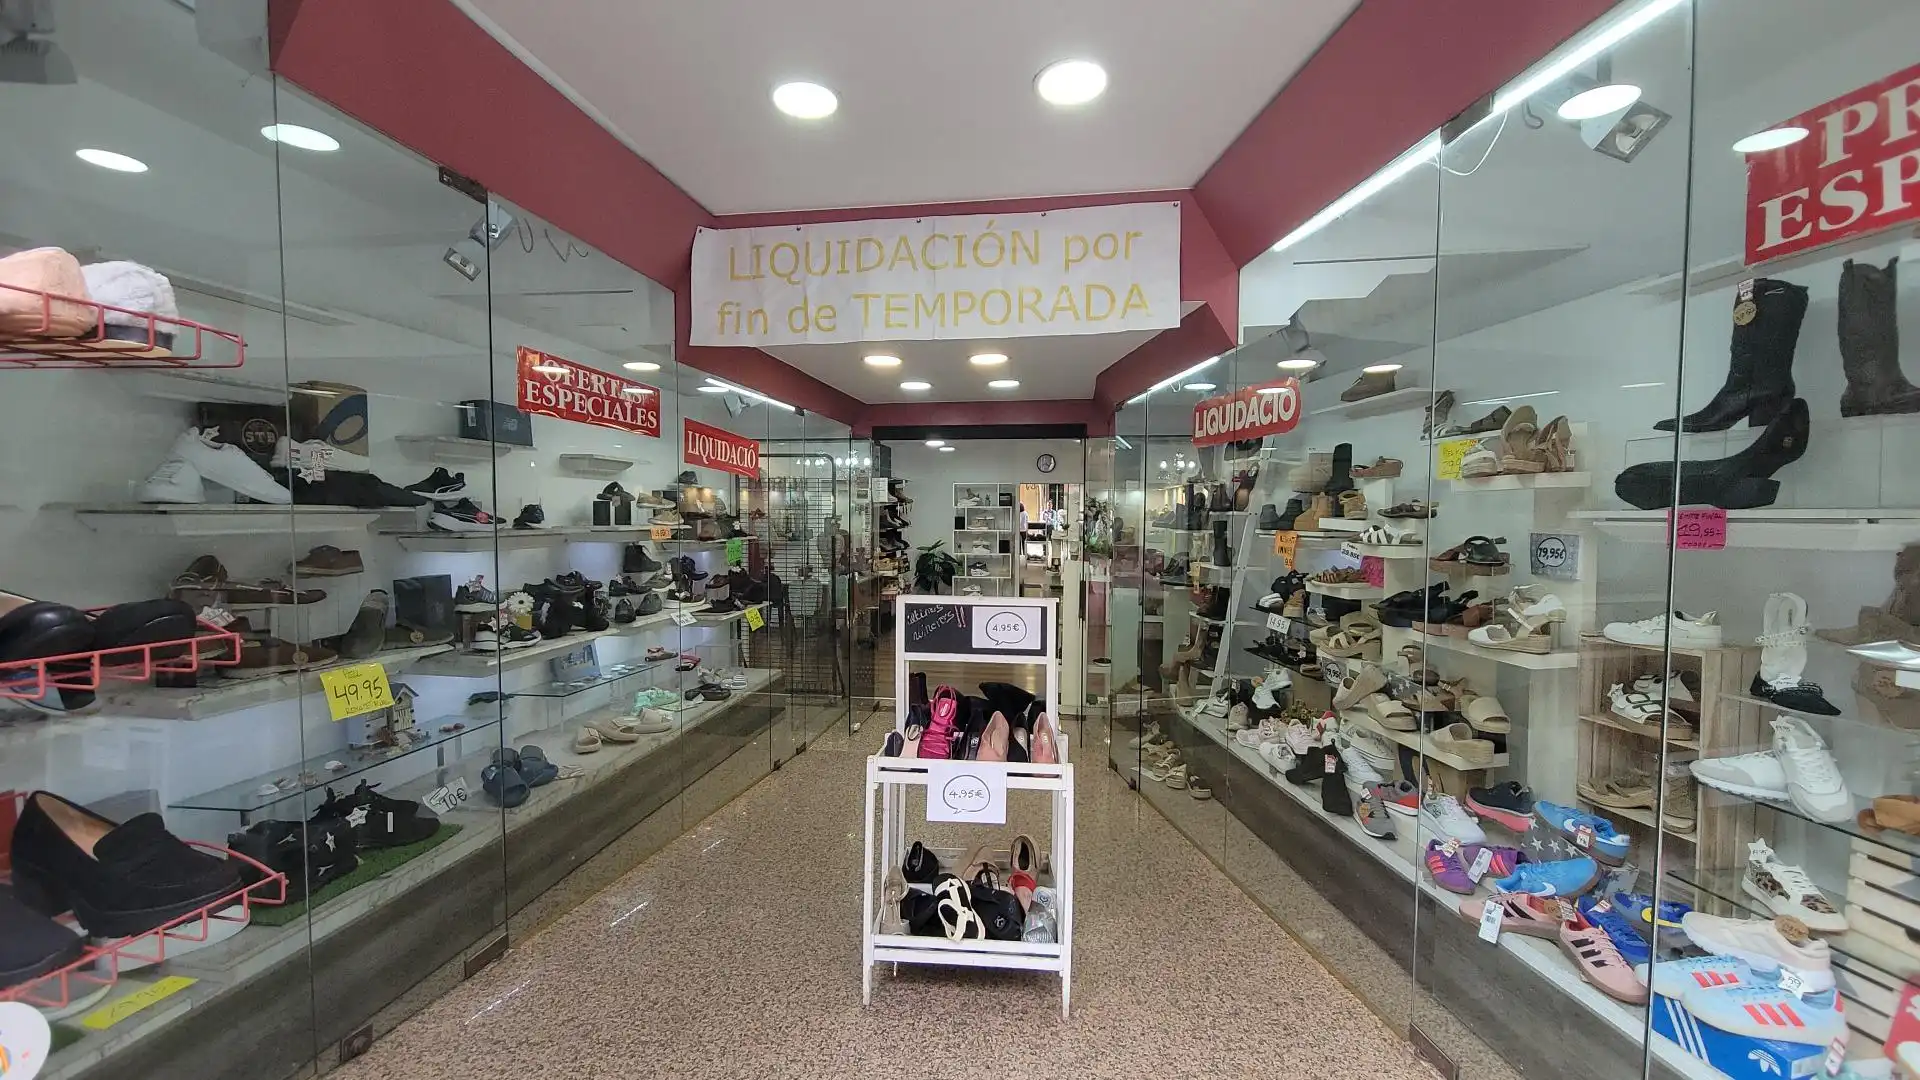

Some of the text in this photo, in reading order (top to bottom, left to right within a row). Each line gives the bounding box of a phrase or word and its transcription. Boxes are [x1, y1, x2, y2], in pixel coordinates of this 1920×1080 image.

[1756, 147, 1920, 251] ESP
[729, 219, 1143, 285] LIQUIDACIÓN por
[717, 283, 1153, 335] fin de TEMPORADA
[524, 379, 657, 429] ESPECIALES
[687, 429, 756, 469] LIQUIDACIÓ
[992, 623, 1020, 633] 4.95€
[333, 676, 383, 706] 49.95
[948, 789, 985, 799] 4.95€
